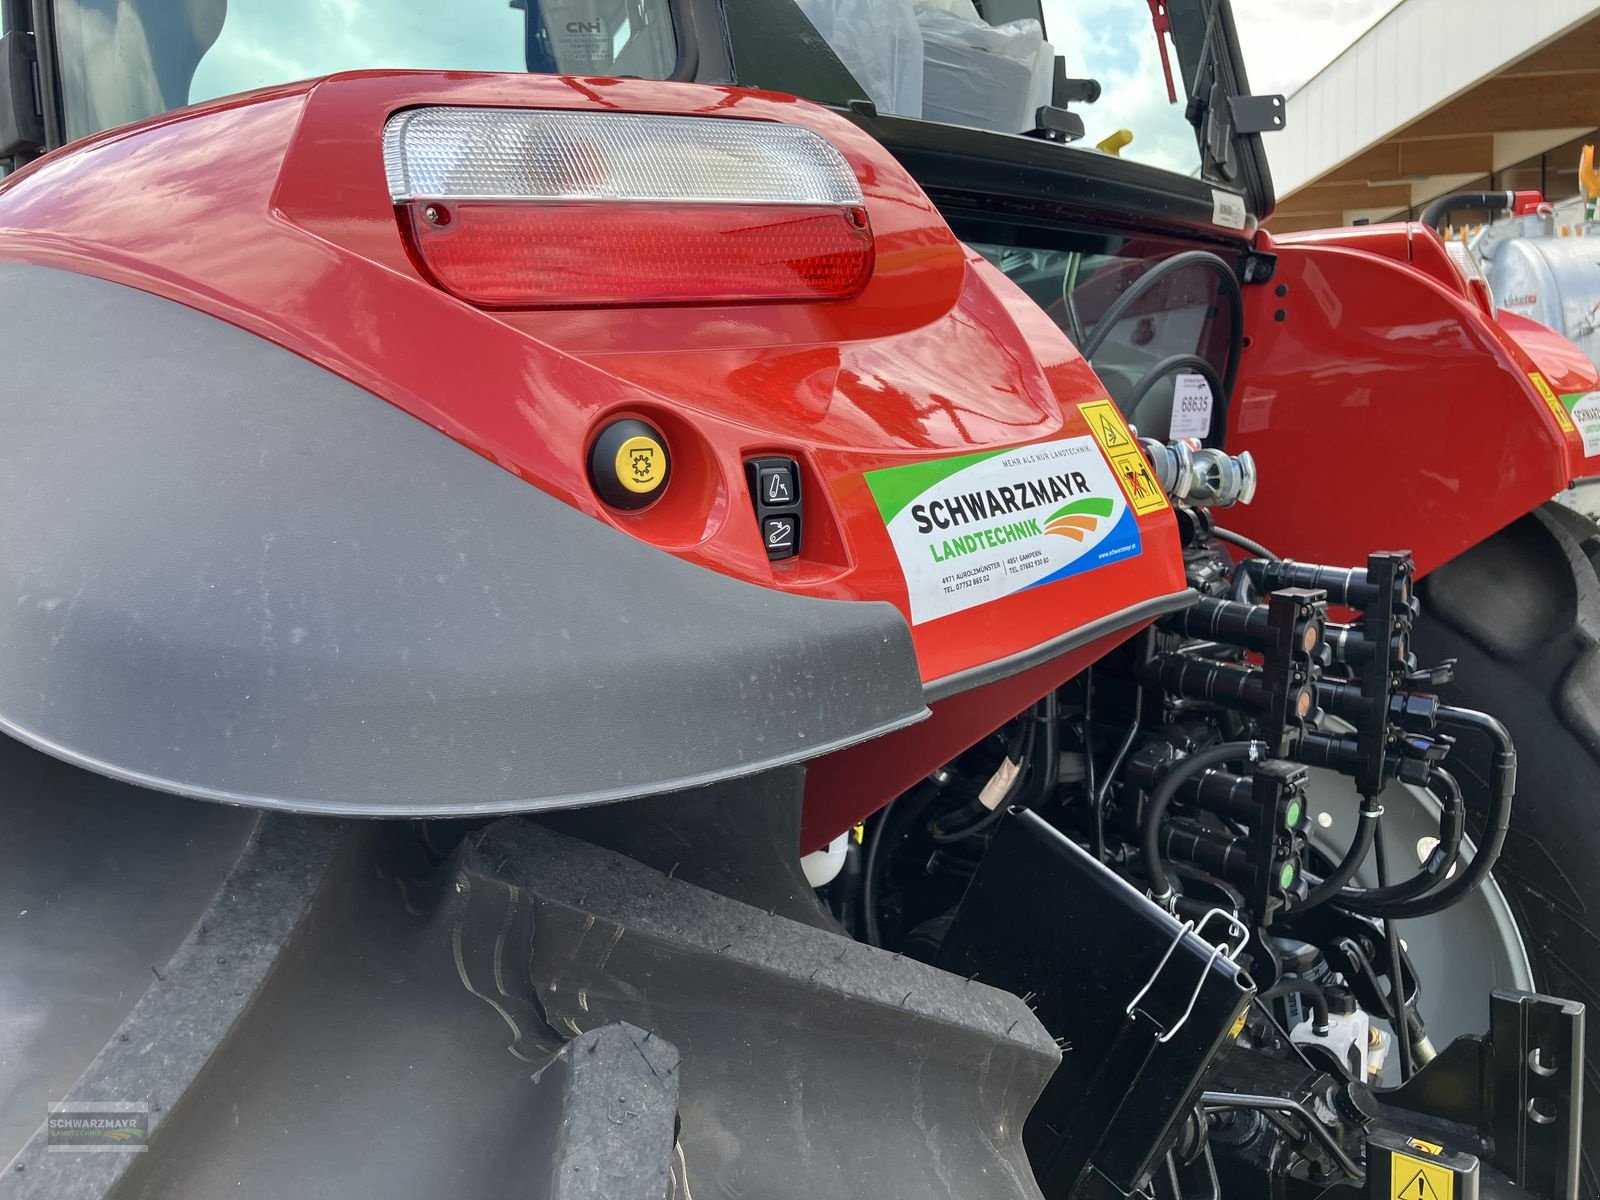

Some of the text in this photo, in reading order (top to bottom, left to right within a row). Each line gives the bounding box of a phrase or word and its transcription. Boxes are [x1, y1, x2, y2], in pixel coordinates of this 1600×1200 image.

[1181, 396, 1208, 412] 68635
[1002, 458, 1022, 468] MEHR
[1022, 455, 1036, 464] ALS
[1036, 452, 1050, 462] NUR
[911, 471, 1091, 534] SCHWARZMAYR
[929, 518, 1042, 563] LANDTECHNIK
[1006, 550, 1042, 565] 4851 GAMPERN
[941, 561, 1001, 584] 4971 AUROLZMÜNSTER
[1008, 566, 1020, 574] TEL.
[943, 574, 990, 594] TEL. 07752 865 02
